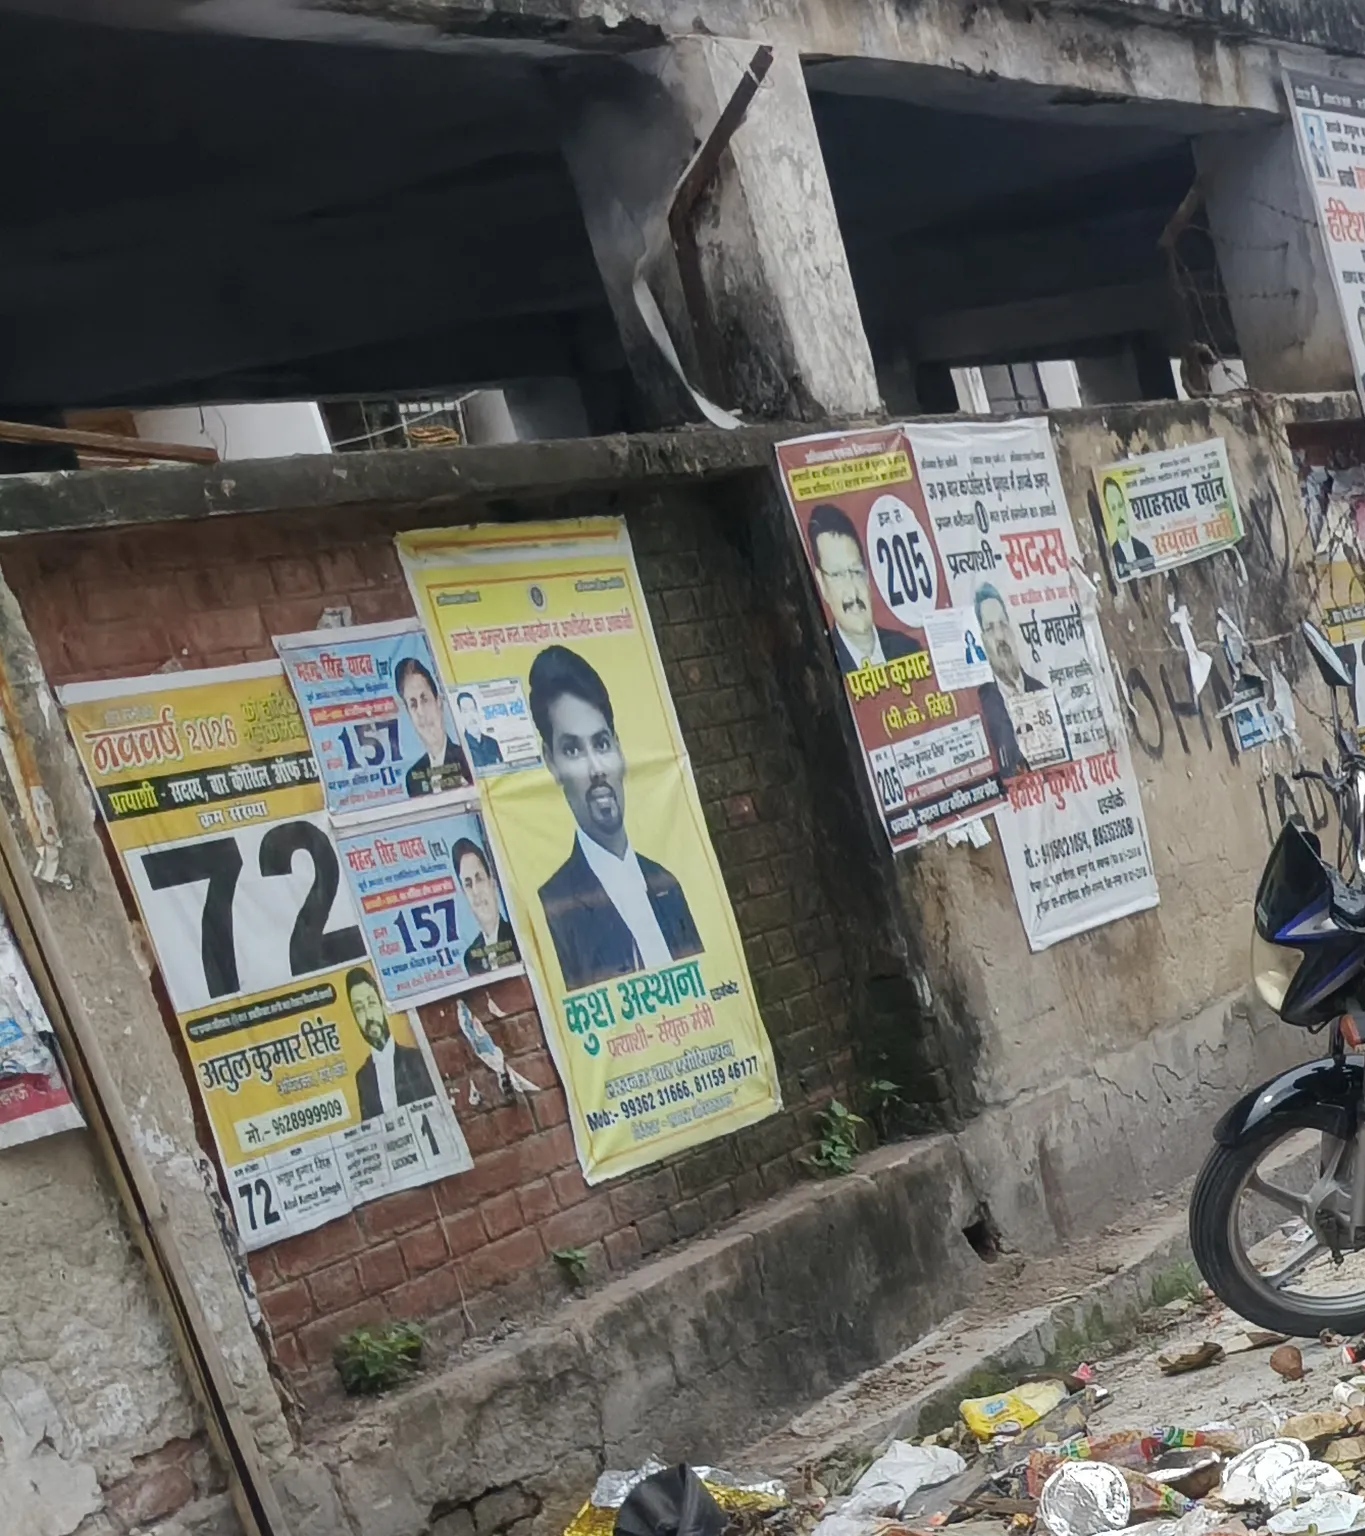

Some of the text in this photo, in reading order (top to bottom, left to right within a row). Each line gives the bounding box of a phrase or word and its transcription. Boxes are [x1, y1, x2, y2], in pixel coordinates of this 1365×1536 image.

[876, 530, 933, 607] 205
[947, 528, 1069, 581] प्रत्याशी- सदस्य
[320, 651, 344, 680] सिंह
[345, 654, 375, 678] यादव
[846, 650, 932, 701] प्रदीप कुमार
[86, 705, 239, 773] नववर्ष 2026
[338, 718, 404, 772] 157
[107, 782, 158, 815] प्रत्याशी
[167, 777, 209, 804] सदस्य,
[207, 772, 230, 798] बार
[877, 767, 904, 807] 205
[200, 800, 269, 829] क्रम संख्या
[375, 836, 397, 865] सिंह
[396, 836, 426, 861] यादव
[141, 819, 369, 1000] 72
[393, 898, 460, 955] 157
[562, 986, 616, 1056] कुश
[616, 960, 706, 1021] अस्थाना
[656, 1013, 690, 1047] संयुक्त
[690, 1003, 716, 1030] मंत्री
[199, 1016, 342, 1092] अतुल कुमार सिंह
[620, 1093, 657, 1119] 99362
[657, 1079, 695, 1107] 31666,
[727, 1055, 760, 1080] 46177
[272, 1099, 344, 1137] 9628999909
[420, 1112, 441, 1156] 1
[238, 1177, 281, 1231] 72
